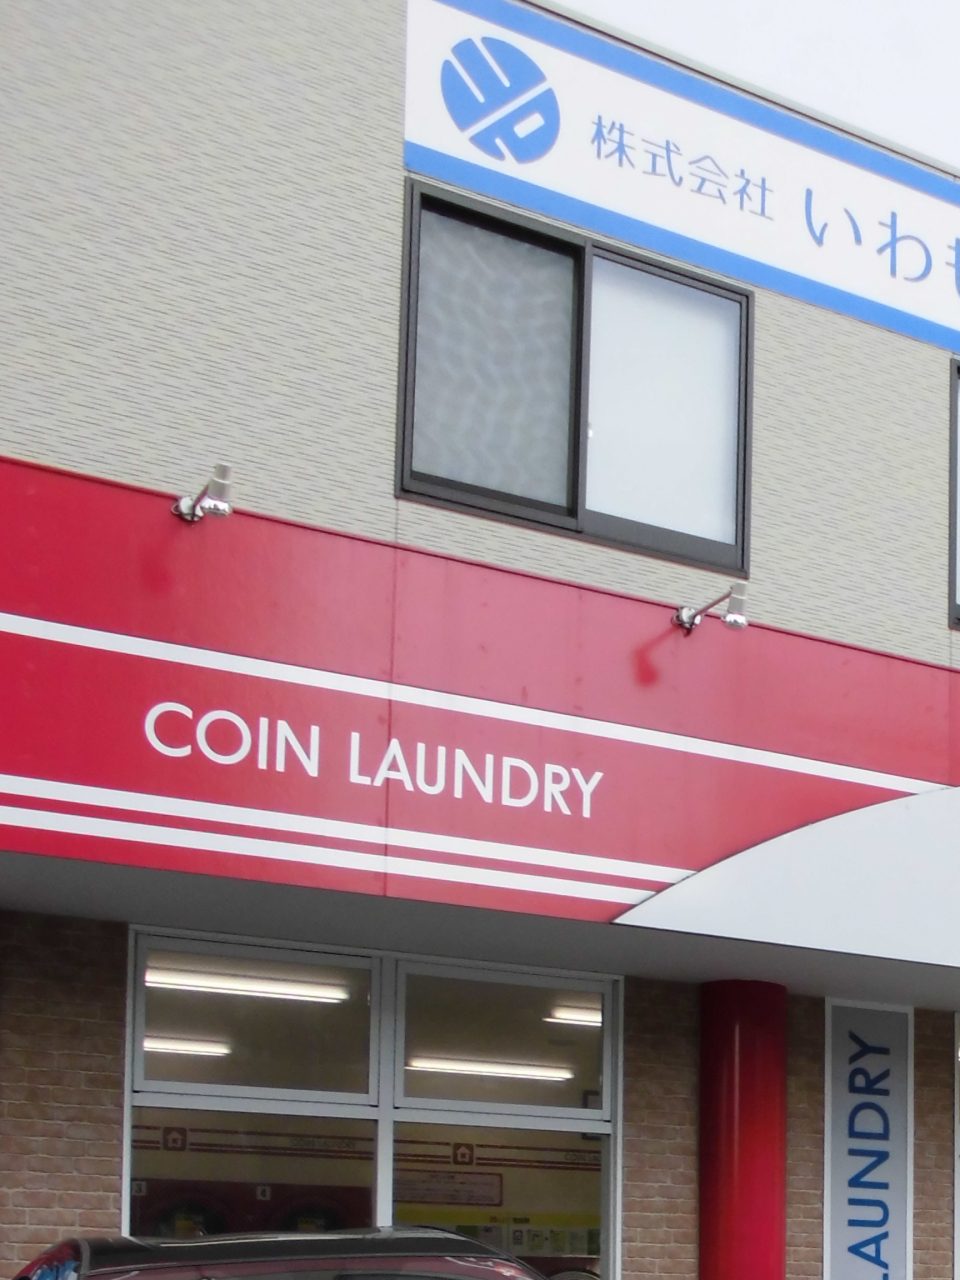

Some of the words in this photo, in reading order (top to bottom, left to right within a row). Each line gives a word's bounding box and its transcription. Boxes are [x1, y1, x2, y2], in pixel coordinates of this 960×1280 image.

[590, 113, 774, 222] 株式会社
[144, 702, 319, 777] COIN
[349, 731, 604, 818] LAUNDRY
